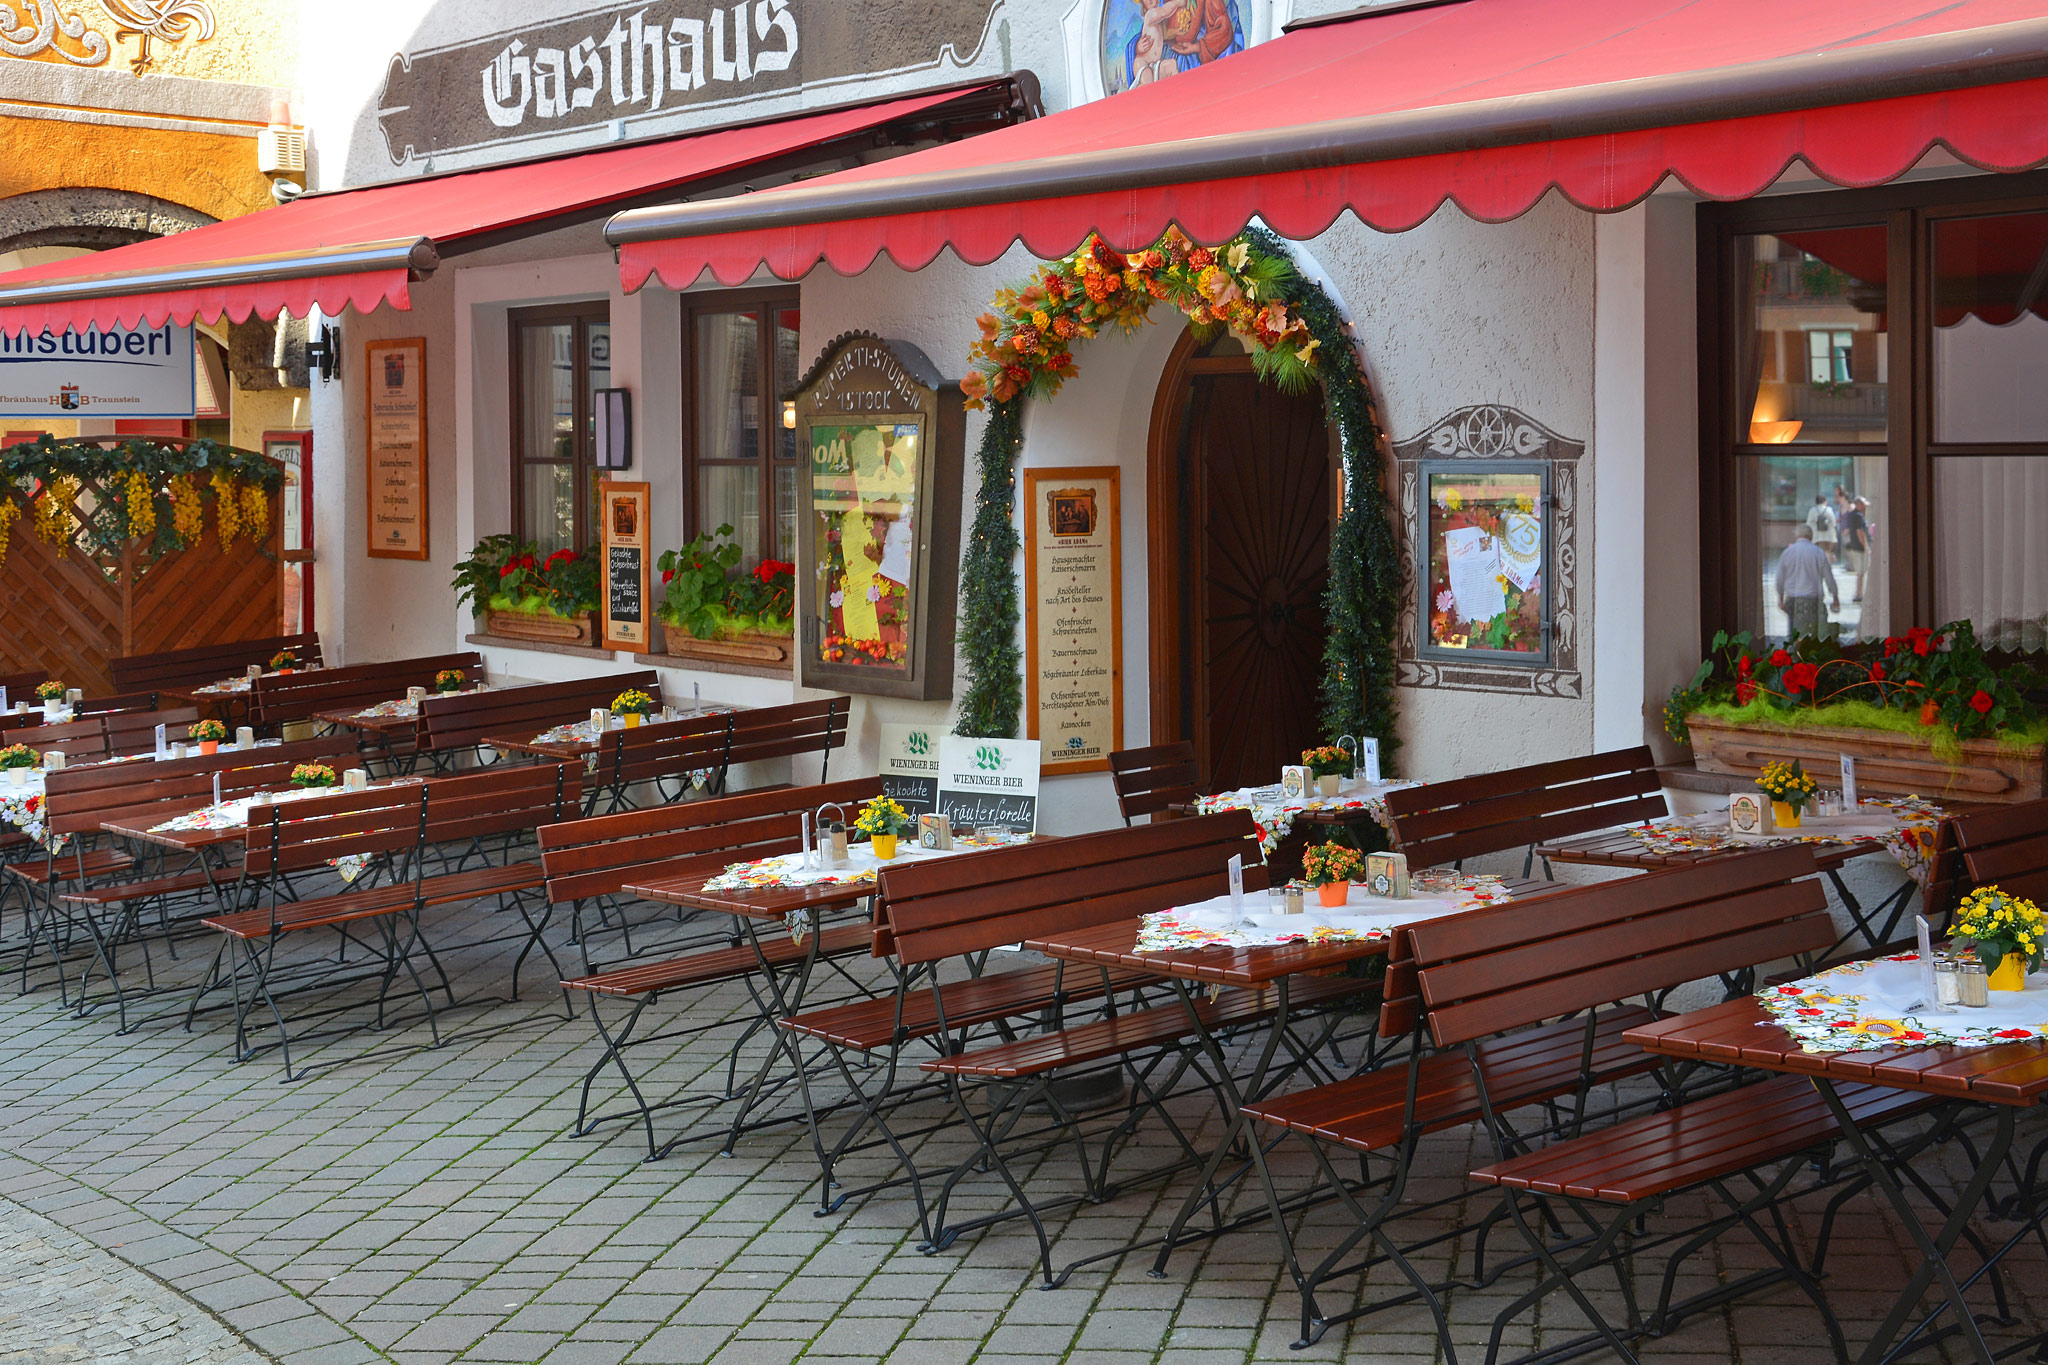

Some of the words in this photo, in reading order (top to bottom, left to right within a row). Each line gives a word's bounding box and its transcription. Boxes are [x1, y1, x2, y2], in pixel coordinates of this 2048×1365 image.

[481, 0, 799, 127] Gasthaus
[92, 395, 141, 403] Traunstein
[1511, 513, 1539, 546] 75
[1052, 647, 1098, 658] Bauernschmaus
[1051, 748, 1086, 758] WIENINGER
[1086, 747, 1101, 755] BIER
[890, 758, 928, 770] WIENINGER
[929, 760, 940, 771] BIE
[953, 774, 1001, 787] WIENINGER
[1002, 777, 1024, 788] BIER
[883, 779, 928, 799] Gekochte
[942, 798, 1032, 827] Kräuterforelle
